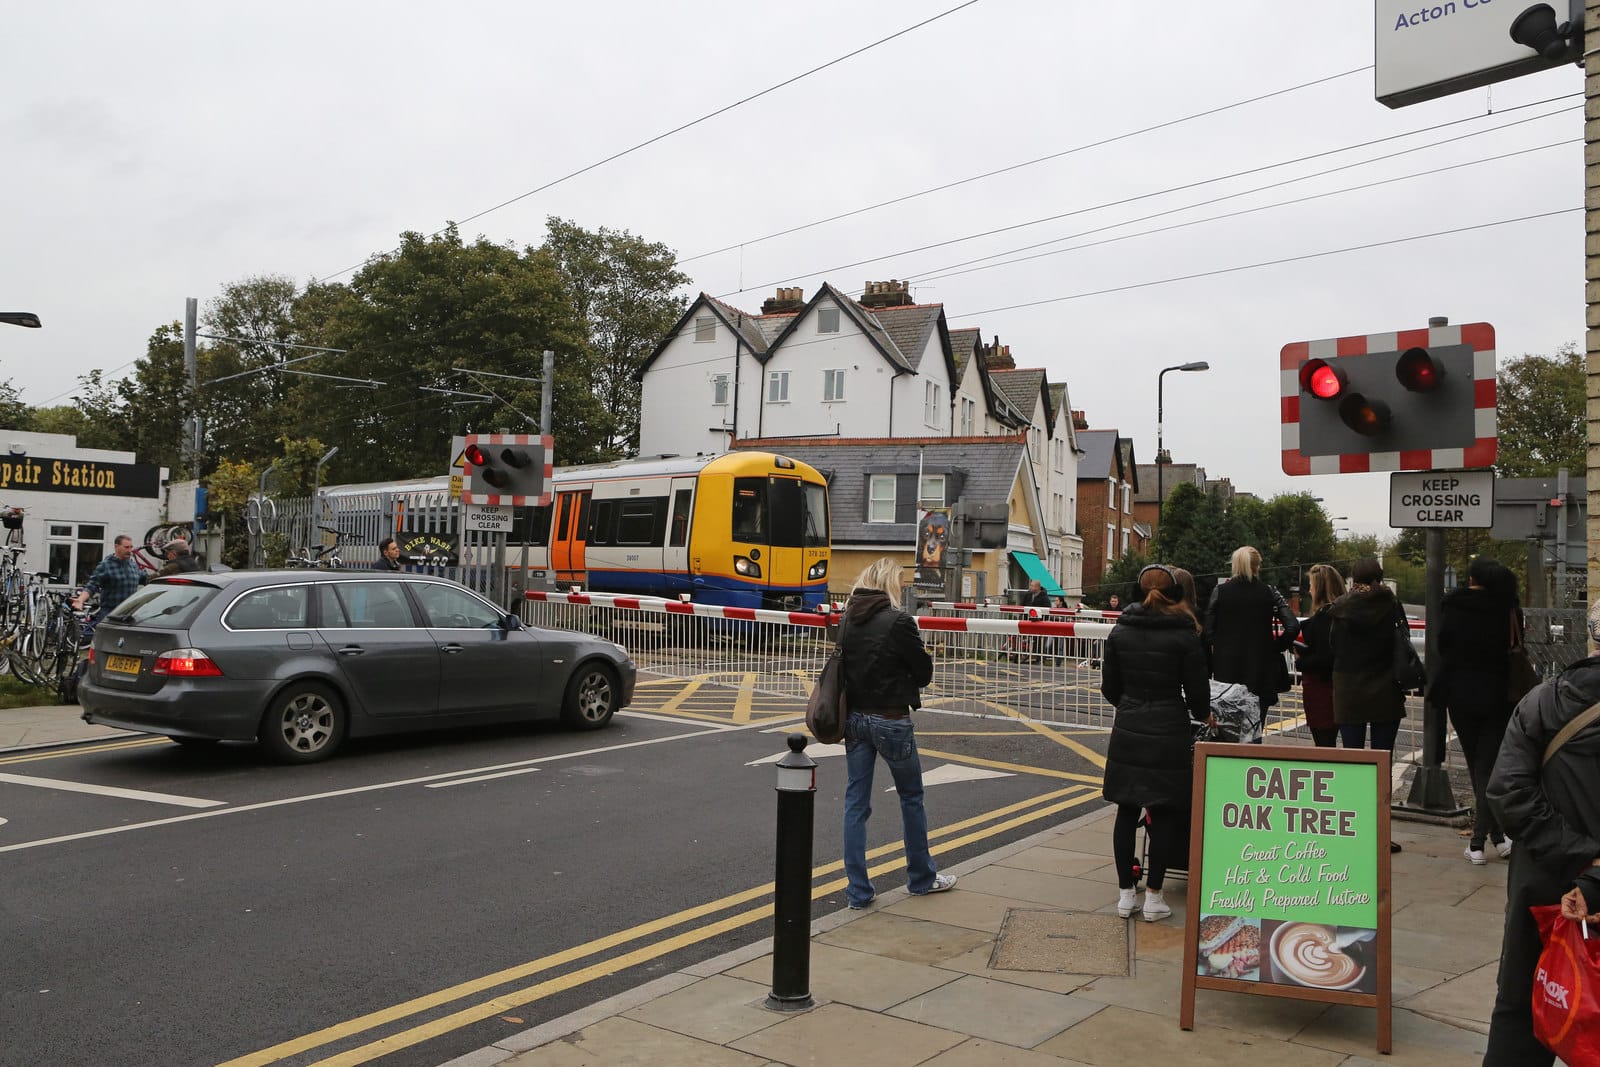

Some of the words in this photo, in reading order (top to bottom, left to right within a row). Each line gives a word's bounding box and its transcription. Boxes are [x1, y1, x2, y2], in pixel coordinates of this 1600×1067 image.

[1394, 2, 1456, 31] Acton
[0, 458, 42, 488] pair
[52, 460, 116, 489] Station
[1422, 479, 1460, 491] KEEP
[1401, 494, 1481, 507] CROSSING
[471, 513, 509, 522] CROSSING
[480, 506, 499, 514] KEEP
[1416, 509, 1464, 522] CLEAR
[478, 521, 501, 529] CLEAR
[404, 536, 426, 551] BIKE
[430, 536, 452, 552] WASH
[1246, 766, 1335, 804] CAFE
[1222, 803, 1273, 831] OAK
[1283, 806, 1357, 837] TREE
[1240, 843, 1282, 862] Great
[1284, 841, 1328, 861] Coffee
[1224, 864, 1254, 886] Hot
[1255, 867, 1271, 884] &
[1277, 864, 1313, 884] Cold
[1317, 863, 1350, 883] Food
[1209, 889, 1255, 913] Freshly
[1262, 887, 1321, 913] Prepared
[1326, 886, 1371, 906] Instore
